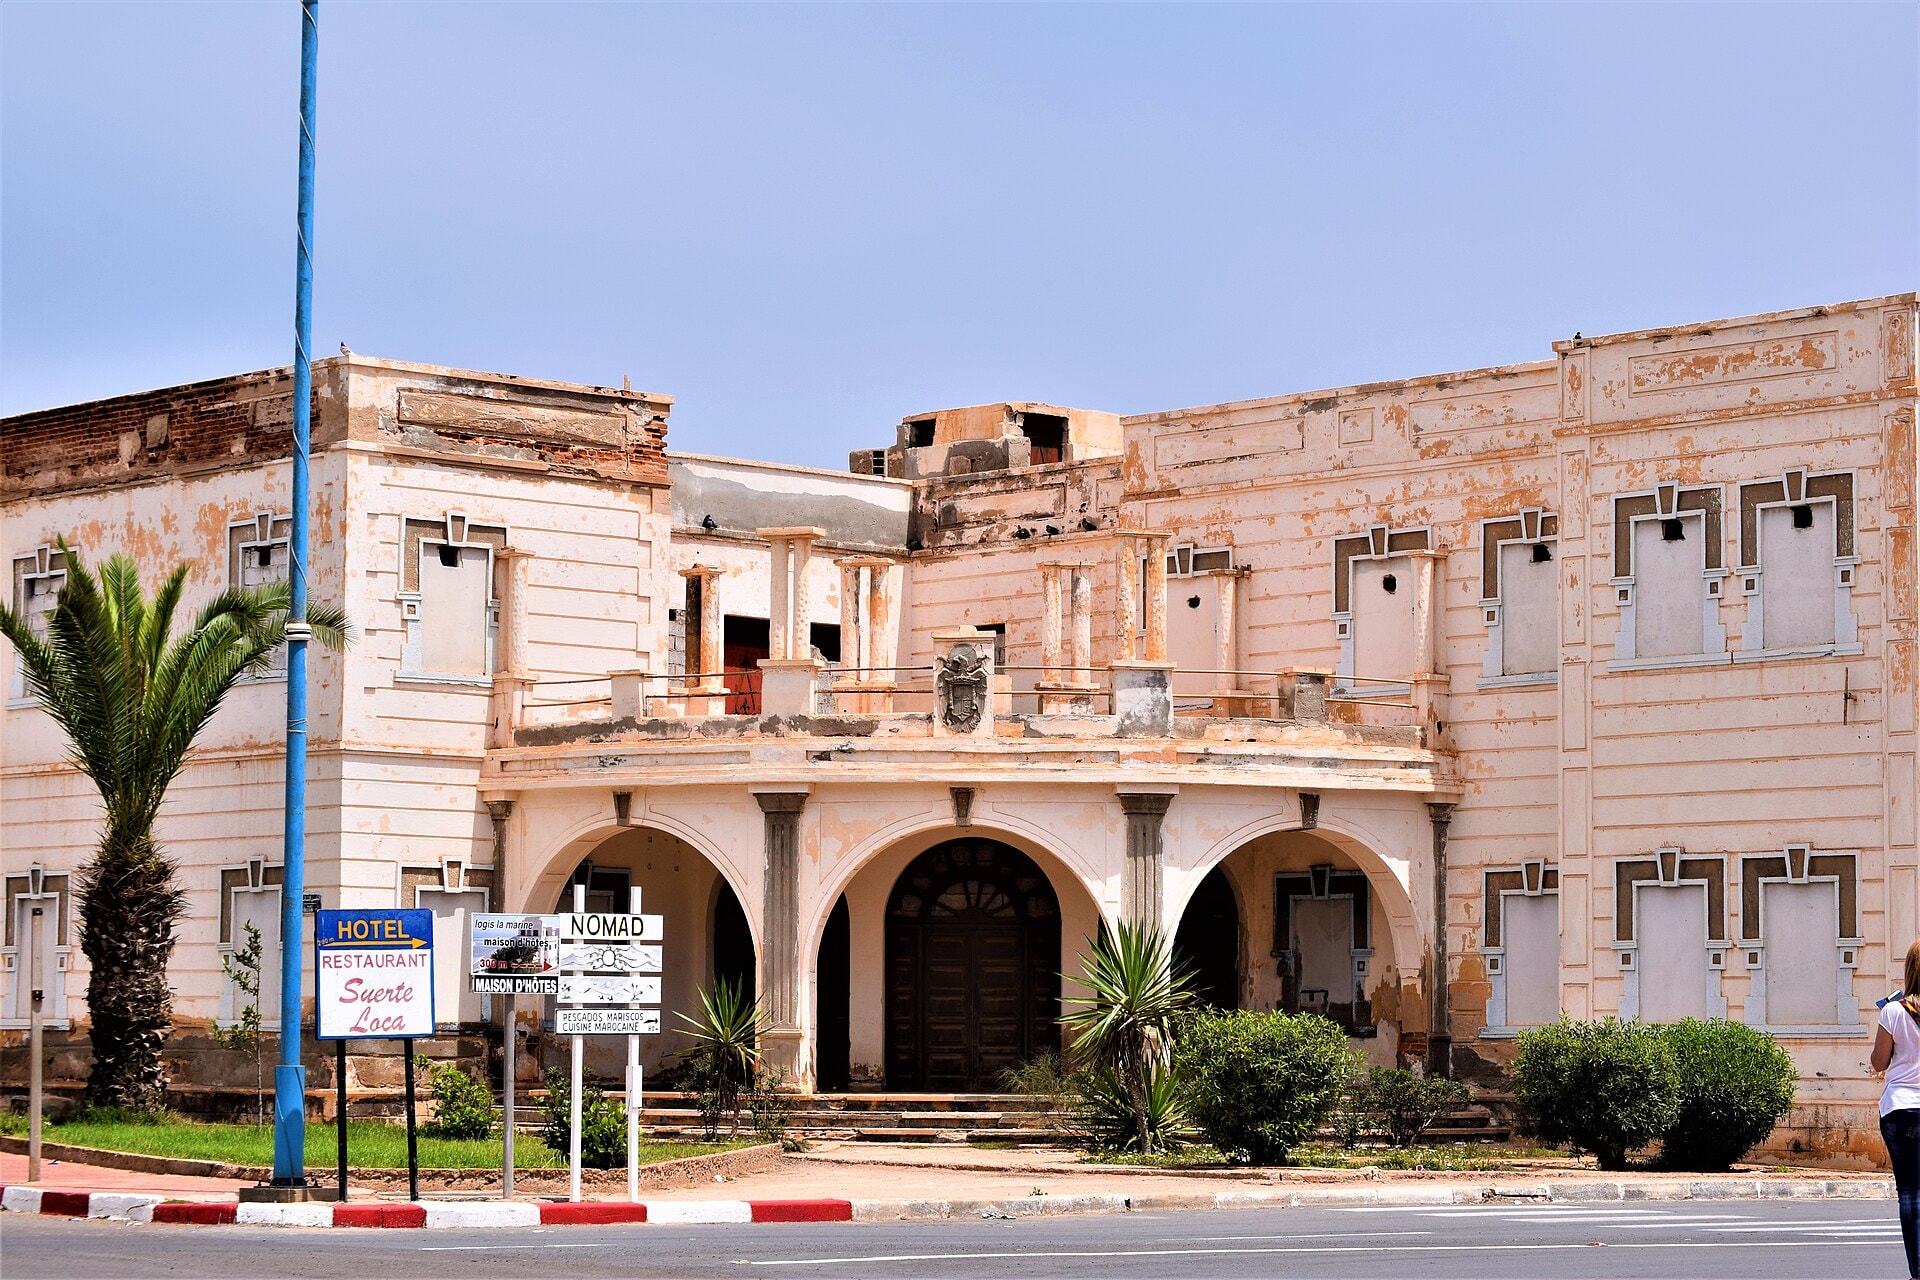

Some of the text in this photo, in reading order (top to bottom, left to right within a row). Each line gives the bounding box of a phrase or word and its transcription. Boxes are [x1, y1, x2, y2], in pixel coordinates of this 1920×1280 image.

[338, 919, 410, 939] HOTEL
[474, 920, 534, 931] logis la marine
[571, 914, 644, 937] NOMAD
[483, 937, 515, 947] maison
[322, 954, 428, 969] RESTAURANT
[479, 959, 496, 968] 300
[339, 977, 414, 1004] Suerte
[475, 978, 513, 992] MAISON
[349, 1006, 406, 1034] Loca
[562, 1012, 644, 1022] PESCADOS MARISCOS
[562, 1022, 640, 1032] CUISINE MAROCAINE
